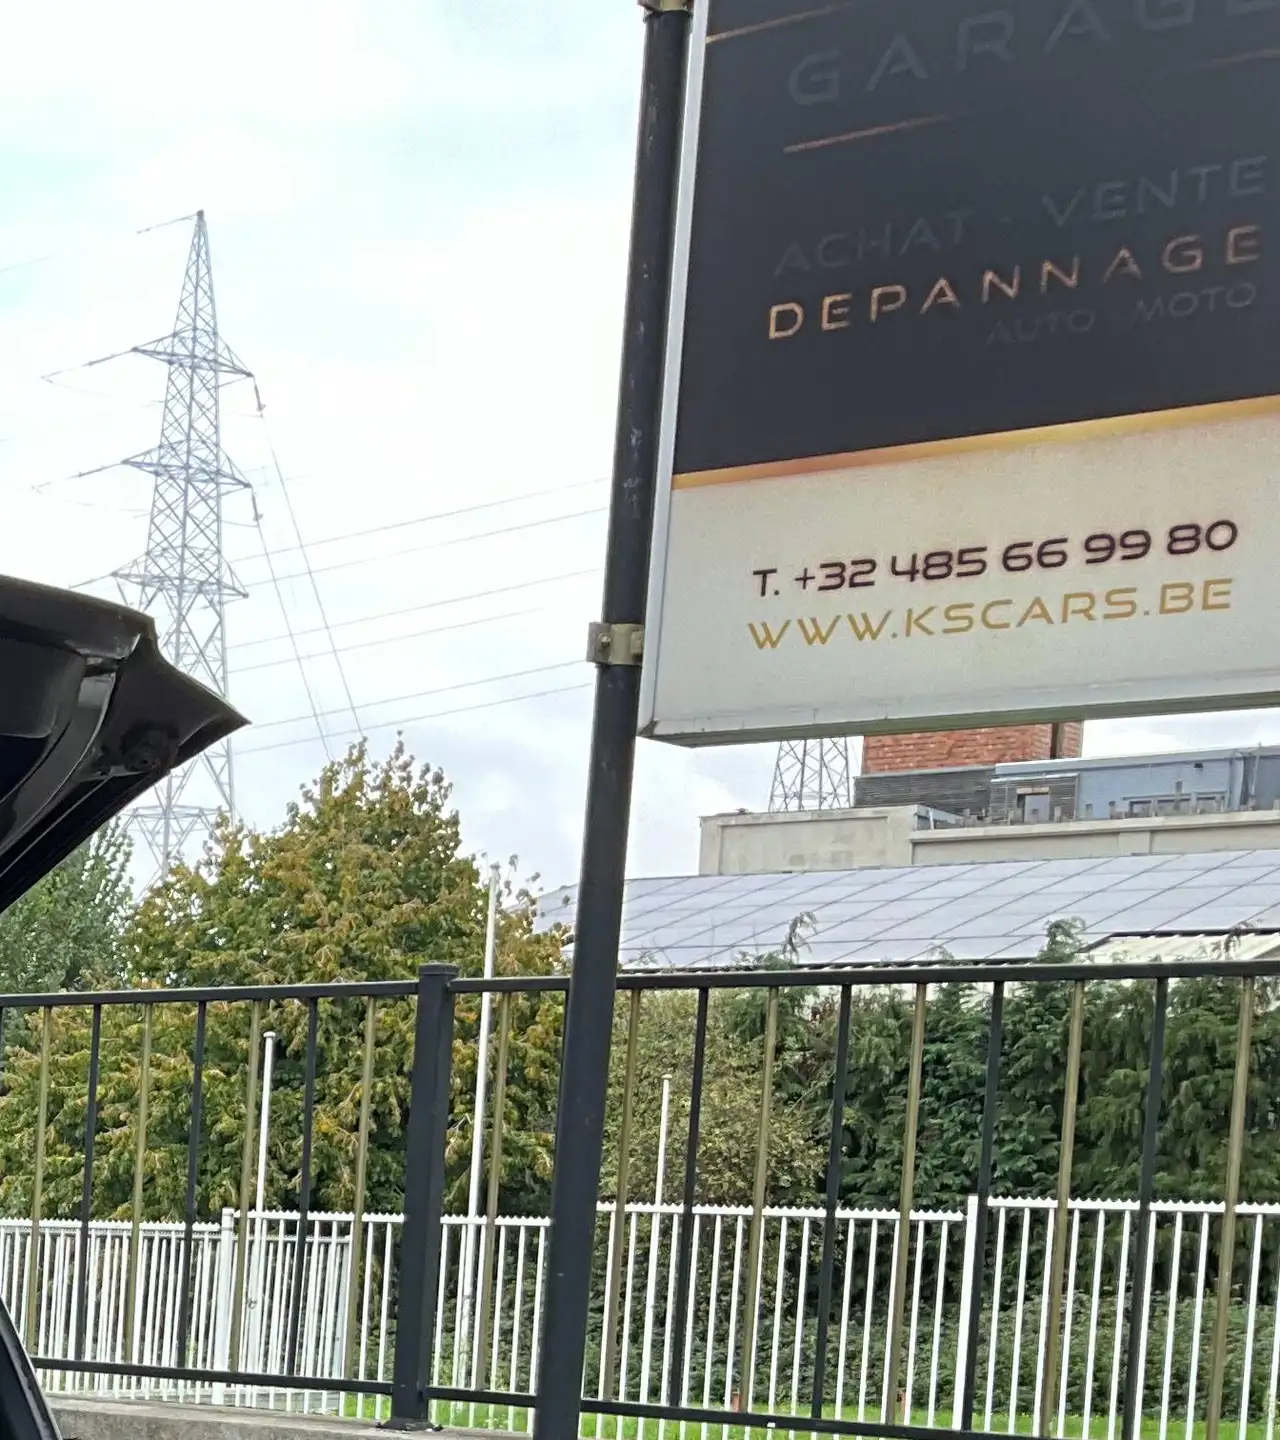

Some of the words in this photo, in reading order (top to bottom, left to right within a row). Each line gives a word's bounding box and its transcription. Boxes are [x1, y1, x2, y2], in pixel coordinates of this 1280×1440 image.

[773, 206, 978, 278] ACHAT
[1041, 154, 1268, 228] VENTE
[768, 224, 1262, 340] DEPANNAGE
[1132, 282, 1258, 324] MOTO
[752, 567, 780, 597] T.
[794, 558, 878, 591] +32
[890, 546, 988, 583] 485
[1002, 537, 1069, 572] 66
[1083, 529, 1152, 564] 99
[1167, 519, 1238, 555] 80
[747, 577, 1234, 650] WWW.KSCARS.BE
